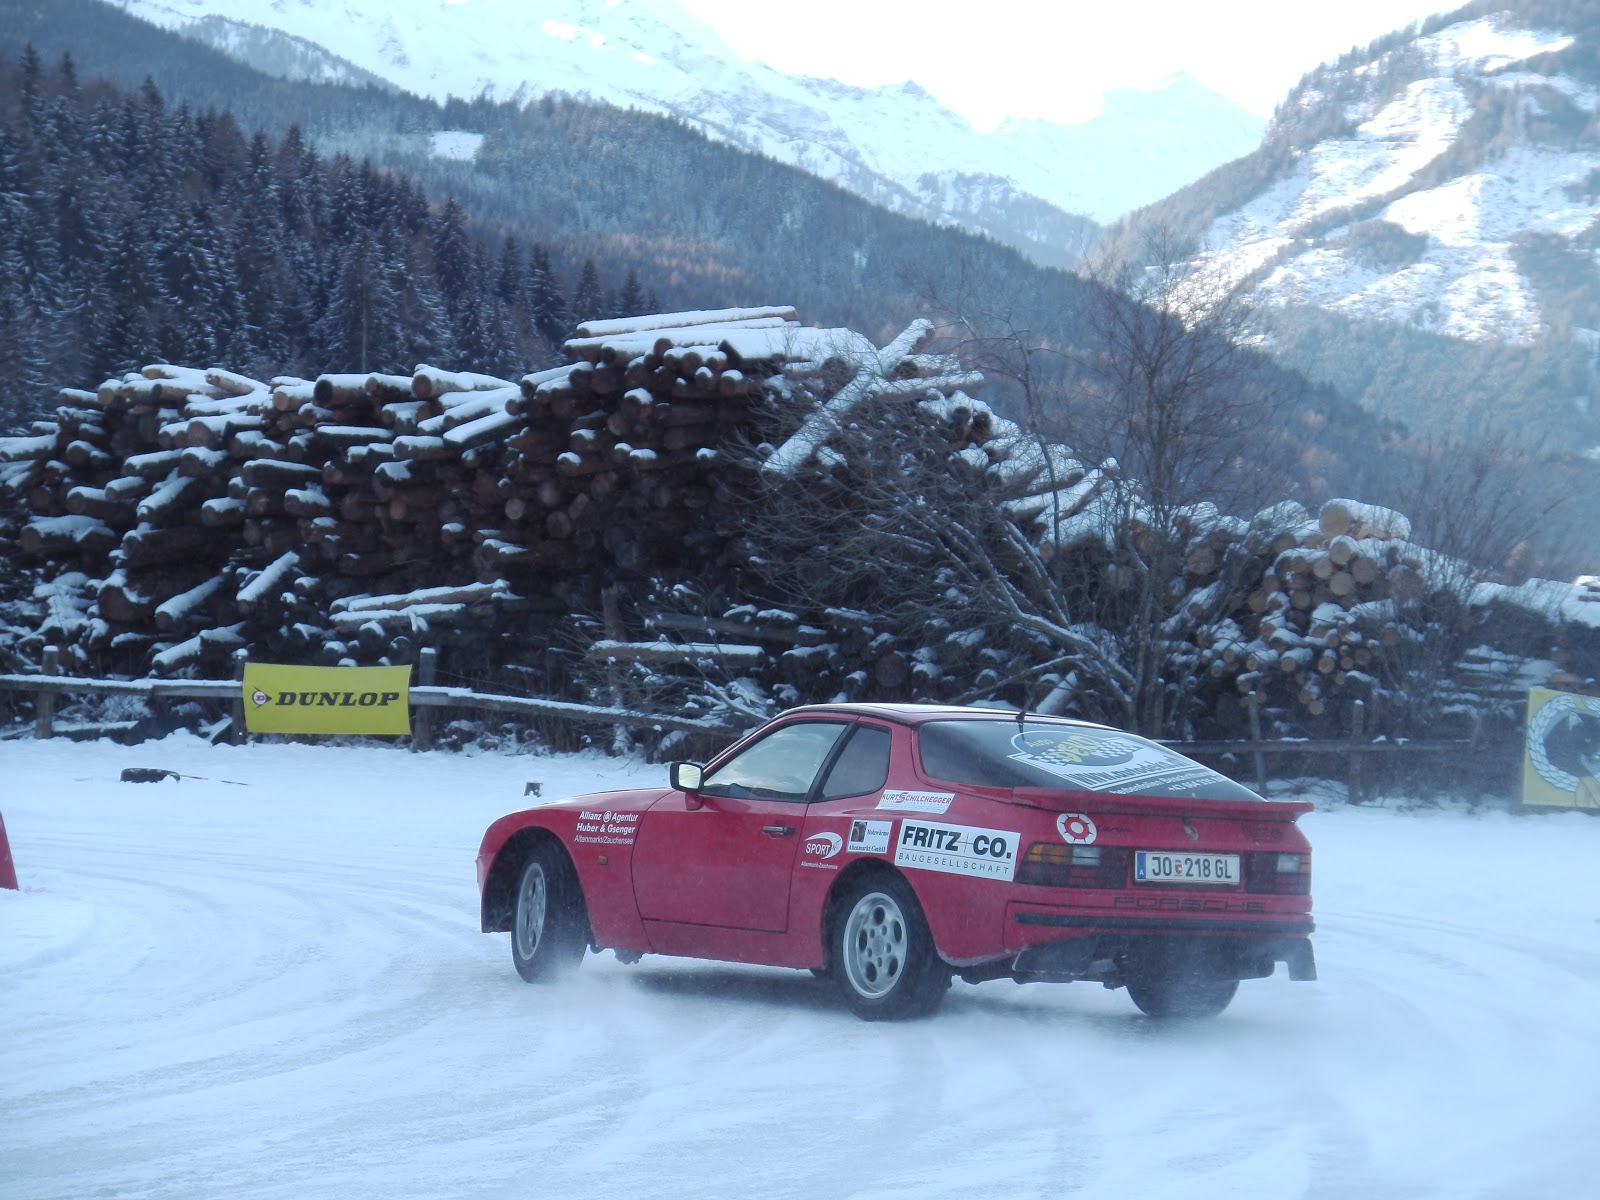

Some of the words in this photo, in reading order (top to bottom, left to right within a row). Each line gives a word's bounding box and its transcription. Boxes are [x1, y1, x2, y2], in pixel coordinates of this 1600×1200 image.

[275, 691, 400, 706] DUNLOP
[882, 793, 899, 801] KURT
[579, 811, 602, 820] Allianz
[611, 812, 638, 823] Agentur
[576, 823, 599, 832] Huber
[600, 824, 605, 832] &
[607, 824, 635, 835] Gsenger
[805, 843, 831, 855] SPORT
[902, 826, 961, 852] FRITZ
[973, 835, 1012, 859] CO.
[898, 853, 1009, 874] BAUGESELLSCHAFT
[1152, 857, 1172, 876] JO
[1185, 858, 1210, 878] 218
[1215, 859, 1232, 879] GL
[1114, 897, 1265, 913] PORSCHE
